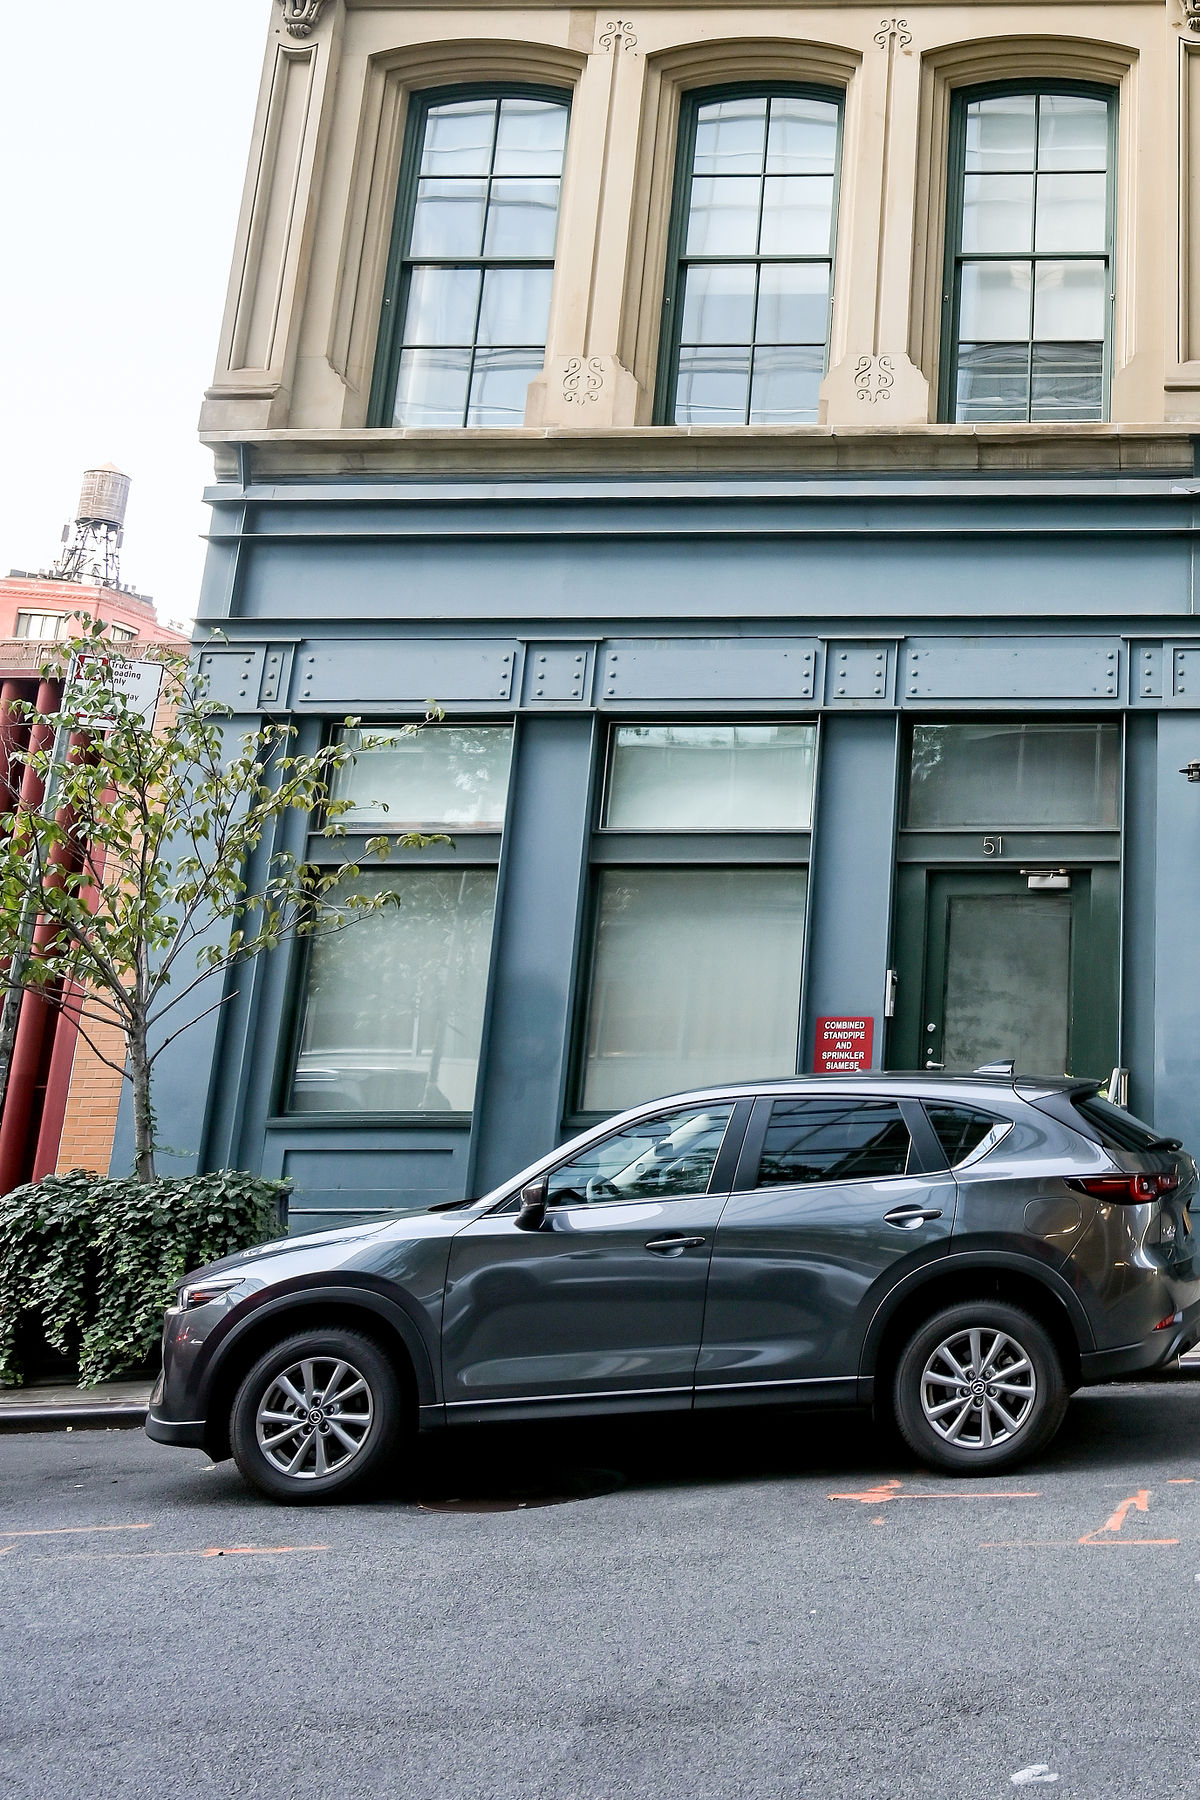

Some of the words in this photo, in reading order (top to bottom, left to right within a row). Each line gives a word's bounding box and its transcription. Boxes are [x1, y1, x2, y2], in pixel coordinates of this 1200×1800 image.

[111, 661, 133, 671] Truck
[113, 670, 142, 680] oading
[983, 836, 1002, 855] 51
[824, 1021, 865, 1029] COMBINED
[823, 1031, 866, 1040] STANDPIPE
[835, 1041, 852, 1050] AND
[821, 1051, 865, 1060] SPRINKLER
[825, 1061, 860, 1070] SIAMESE
